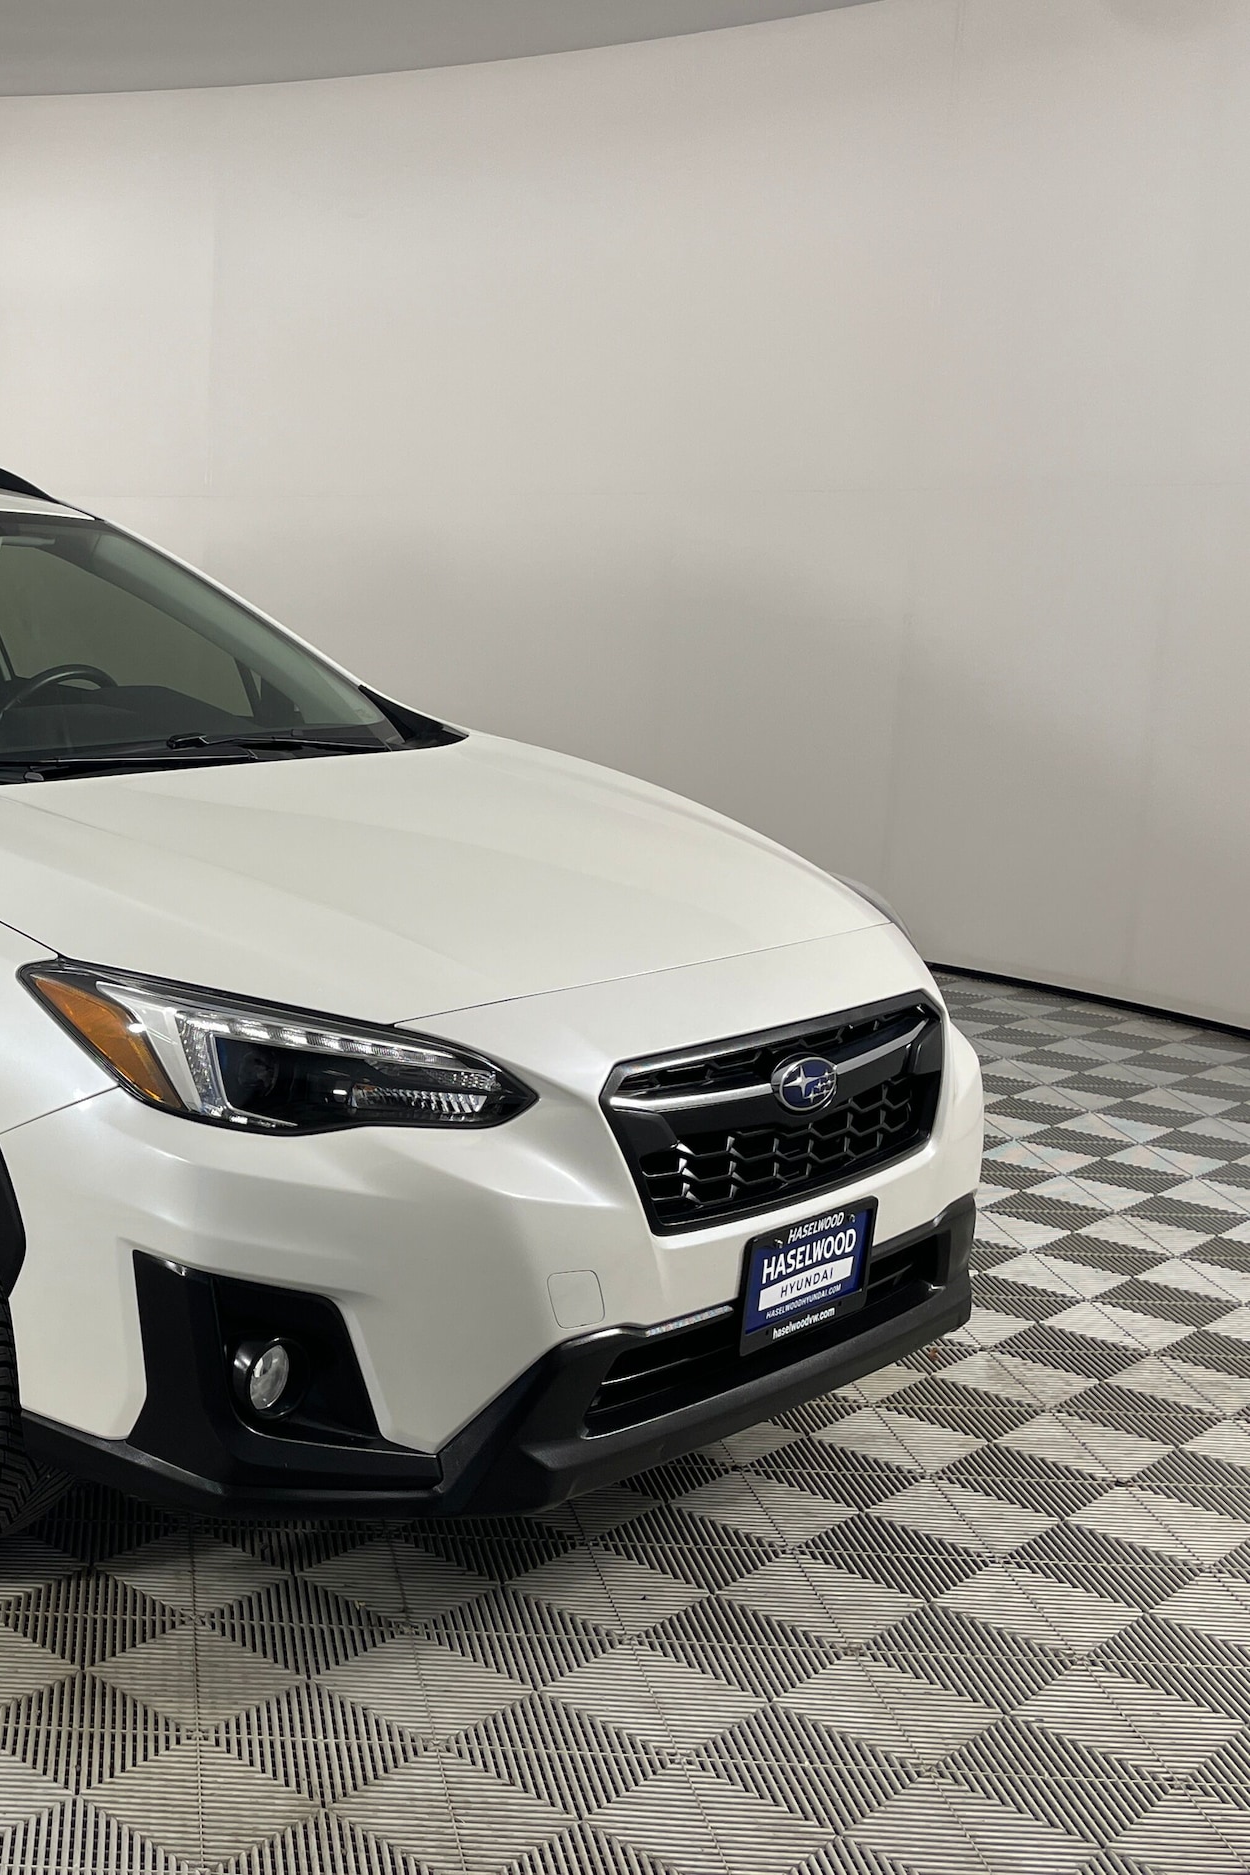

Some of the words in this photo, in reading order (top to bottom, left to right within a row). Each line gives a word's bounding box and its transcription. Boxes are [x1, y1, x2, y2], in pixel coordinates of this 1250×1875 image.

[788, 1212, 845, 1244] HASELWOOD
[762, 1228, 857, 1284] HASELWOOD
[780, 1267, 834, 1298] HYUNDAI
[772, 1307, 835, 1340] haselwoodvw.com
